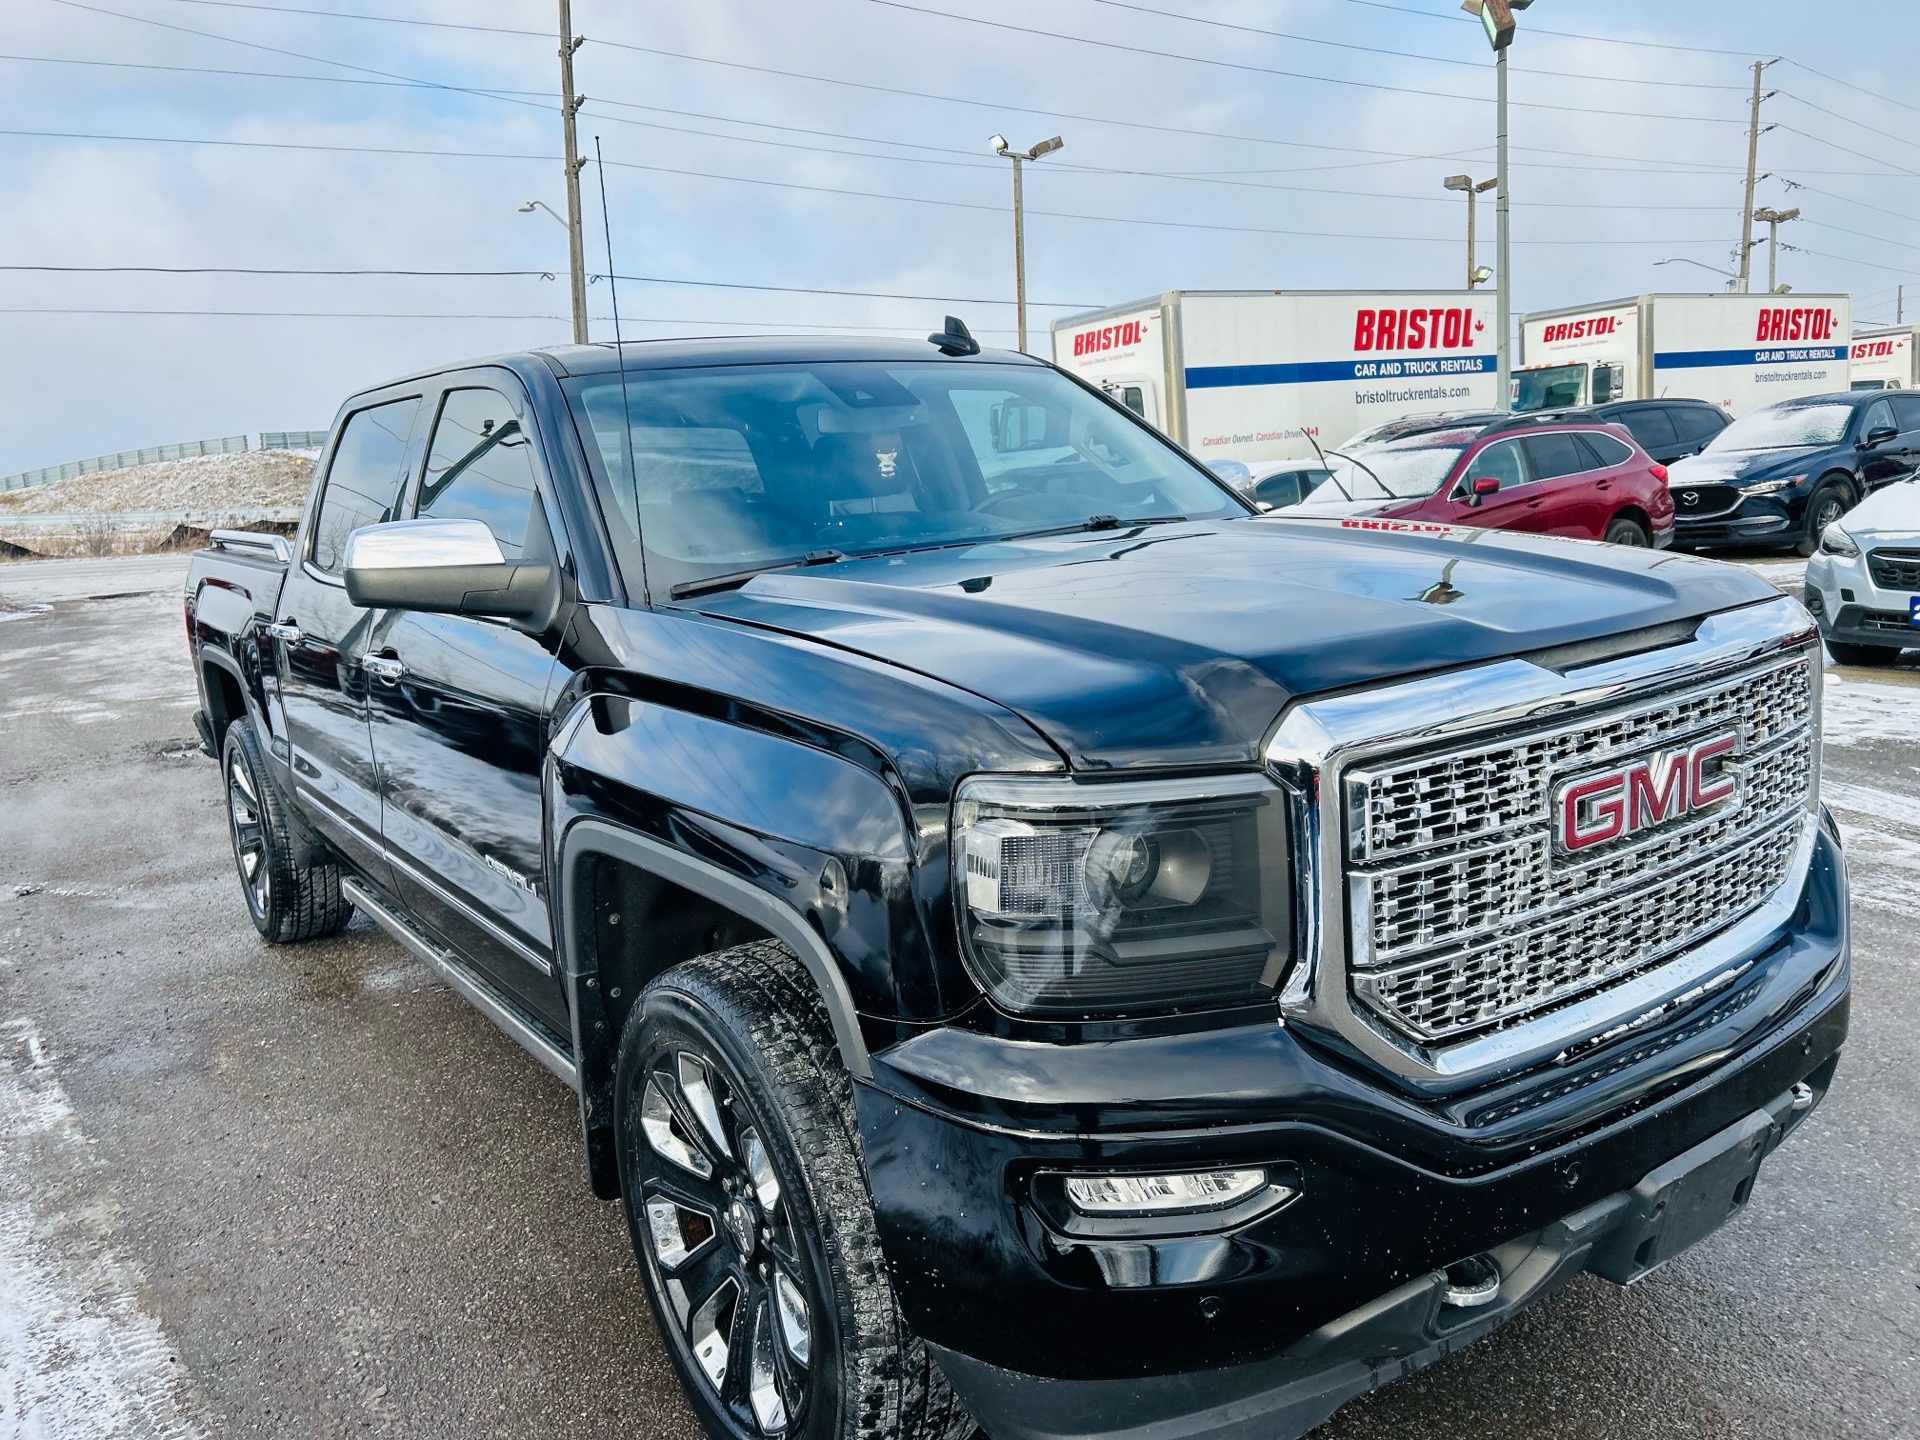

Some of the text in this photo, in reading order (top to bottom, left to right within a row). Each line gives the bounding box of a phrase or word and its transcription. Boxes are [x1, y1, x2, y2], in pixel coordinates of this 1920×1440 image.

[1352, 308, 1474, 351] BRISTOL
[1543, 316, 1616, 343] BRISTOL
[1756, 308, 1832, 341] BRISTOL
[1074, 320, 1142, 357] BRISTOL
[1755, 348, 1836, 362] CAR AND TRUCK RENTALS
[1850, 340, 1894, 359] ISTOL
[1354, 358, 1483, 377] CAR AND TRUCK RENTALS
[1755, 369, 1827, 383] bristoltruckrentals.com
[1355, 386, 1470, 405] bristoltruckrentals.com
[1202, 436, 1231, 447] Canadian
[1256, 431, 1283, 442] Canadian
[1558, 730, 1739, 851] GMC
